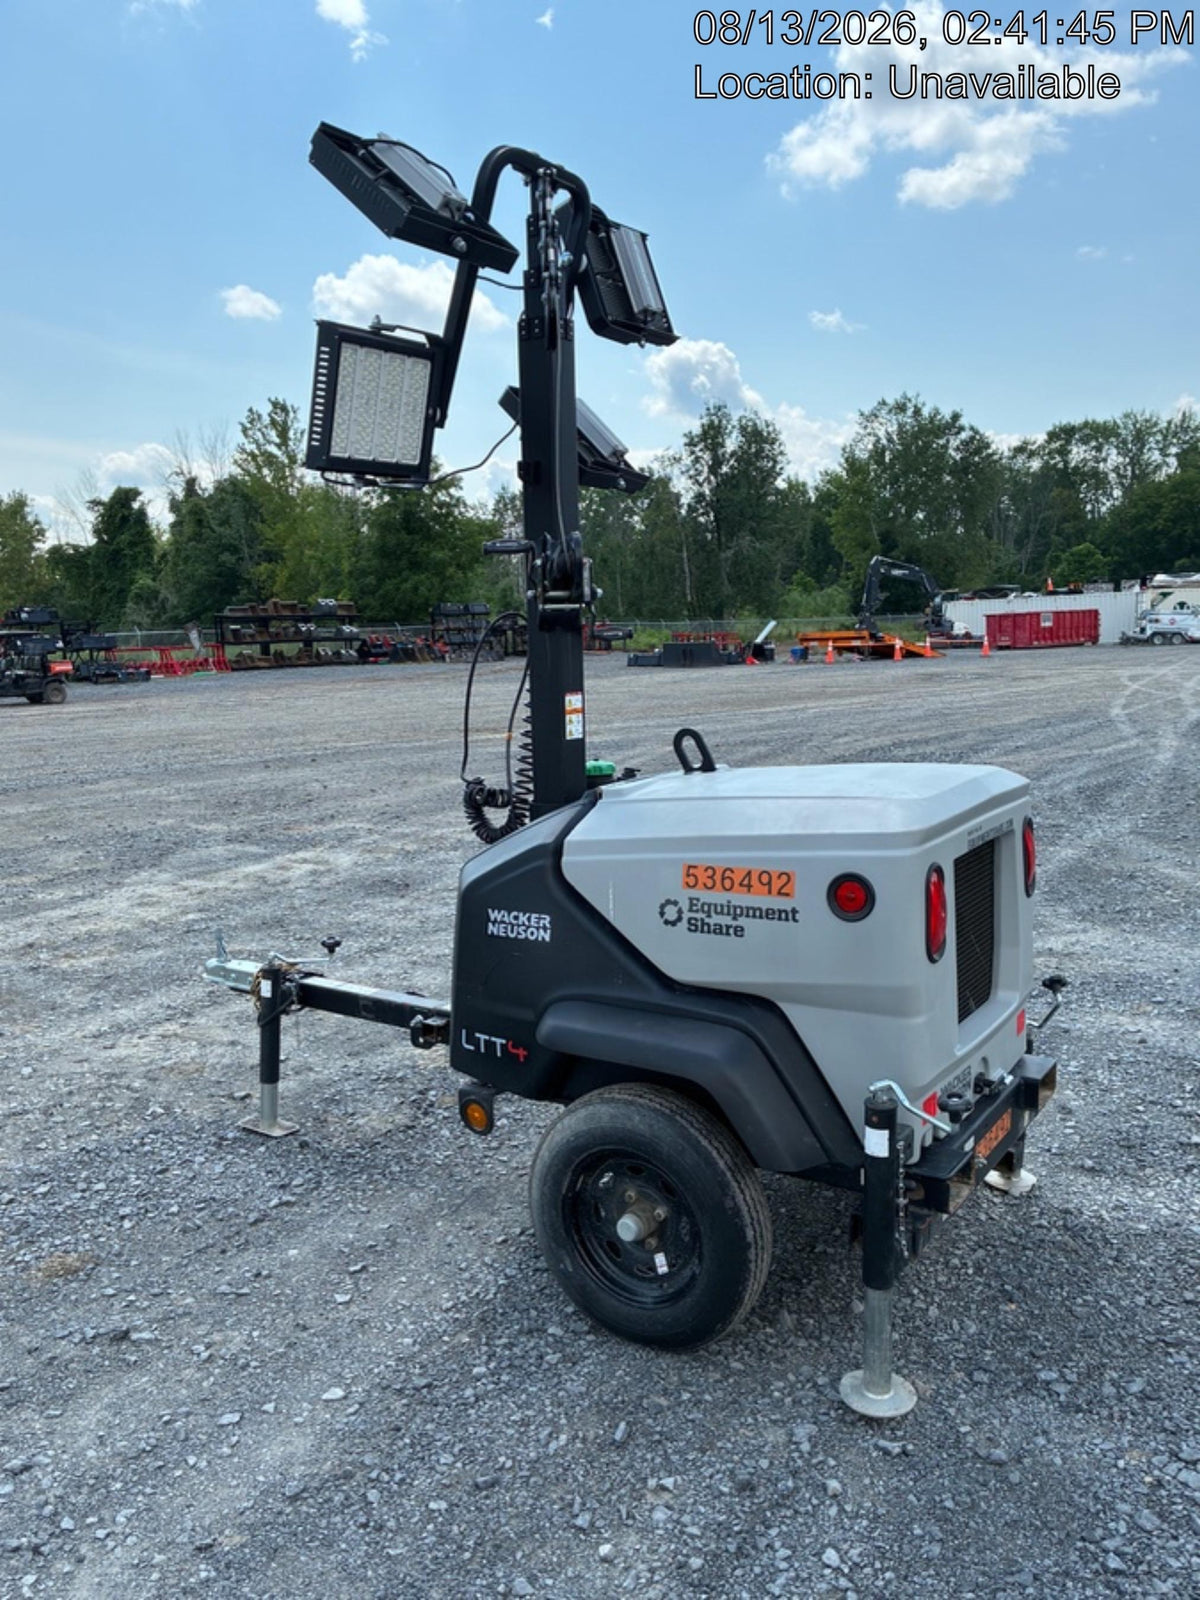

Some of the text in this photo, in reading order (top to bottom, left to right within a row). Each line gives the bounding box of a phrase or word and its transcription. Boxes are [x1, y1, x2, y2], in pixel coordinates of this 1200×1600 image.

[685, 865, 792, 897] 536492
[487, 909, 551, 927] WACKER
[687, 897, 800, 923] Equipment
[487, 922, 551, 942] NEUSON
[687, 917, 745, 938] Share
[461, 1028, 528, 1062] LTT4
